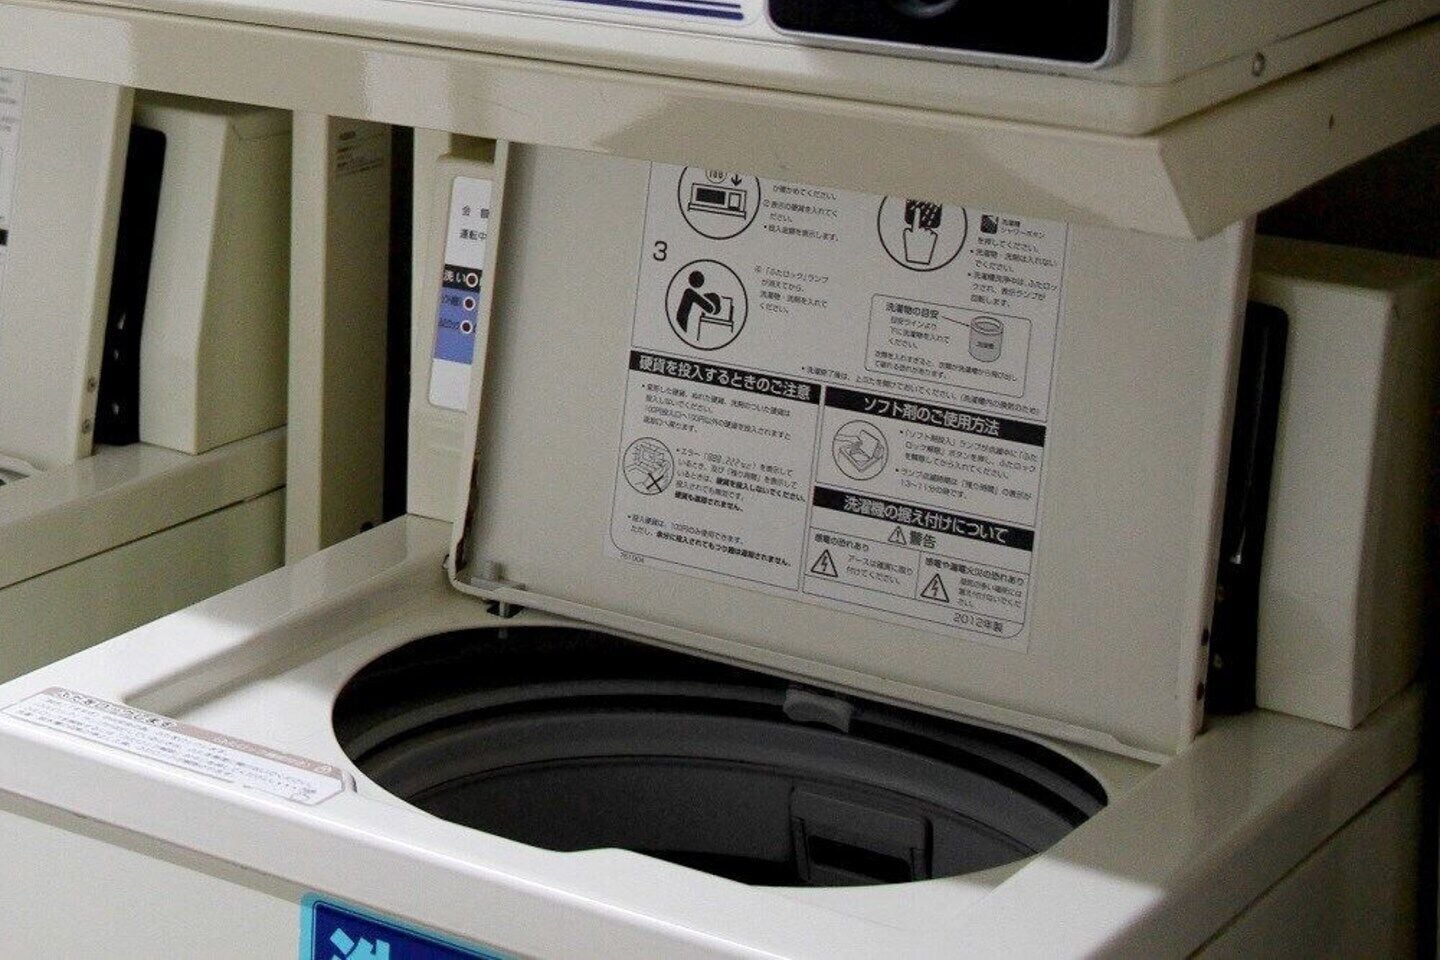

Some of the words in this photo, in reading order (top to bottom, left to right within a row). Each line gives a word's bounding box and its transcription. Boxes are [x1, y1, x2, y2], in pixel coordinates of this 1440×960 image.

[653, 240, 668, 262] 3
[639, 354, 812, 400] 硬貨を投入するときのご注意
[864, 396, 1000, 437] ソフト剤のご使用方法
[844, 494, 1009, 545] 洗濯機の据え付けについて
[909, 529, 937, 550] 警告
